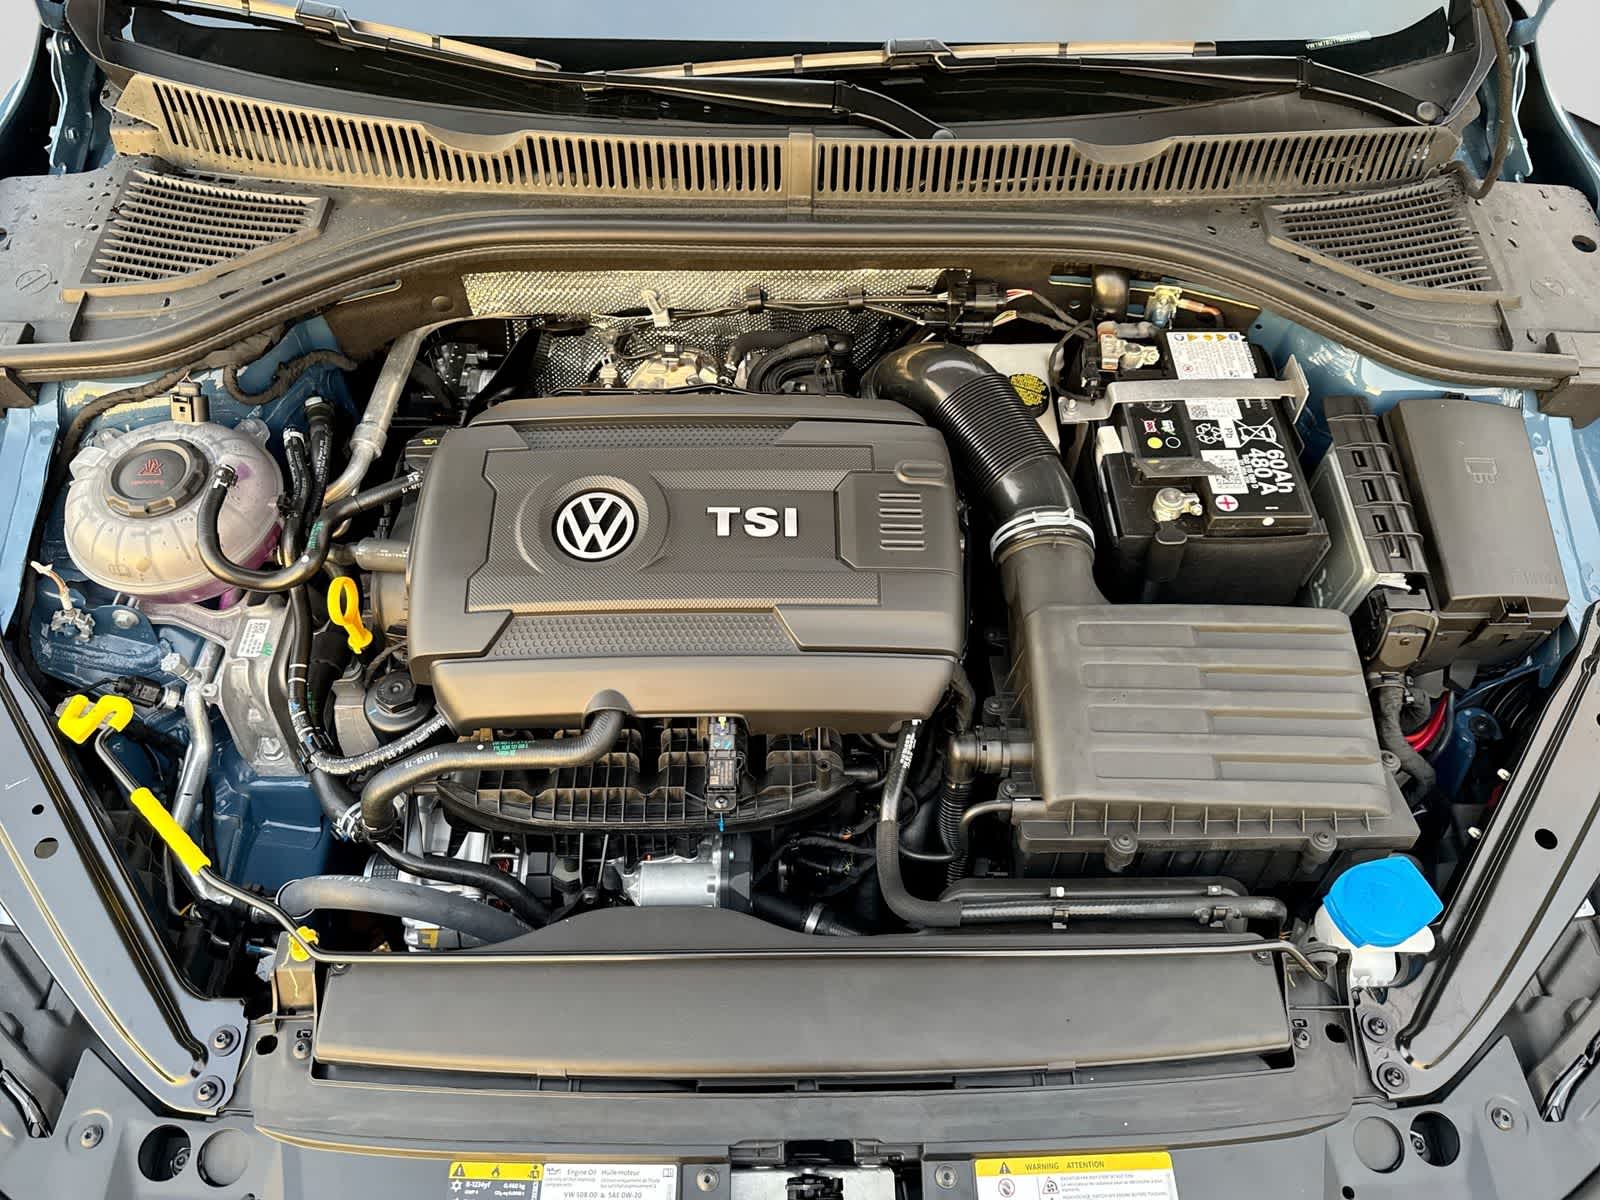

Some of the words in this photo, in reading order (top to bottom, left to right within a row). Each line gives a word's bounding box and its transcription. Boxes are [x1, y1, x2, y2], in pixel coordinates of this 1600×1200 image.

[1249, 448, 1274, 478] 480
[1266, 449, 1296, 493] 60Ah
[1257, 481, 1279, 496] A
[706, 505, 798, 538] TSI
[1025, 1162, 1060, 1171] WARNING
[1066, 1160, 1105, 1169] ATTENTION
